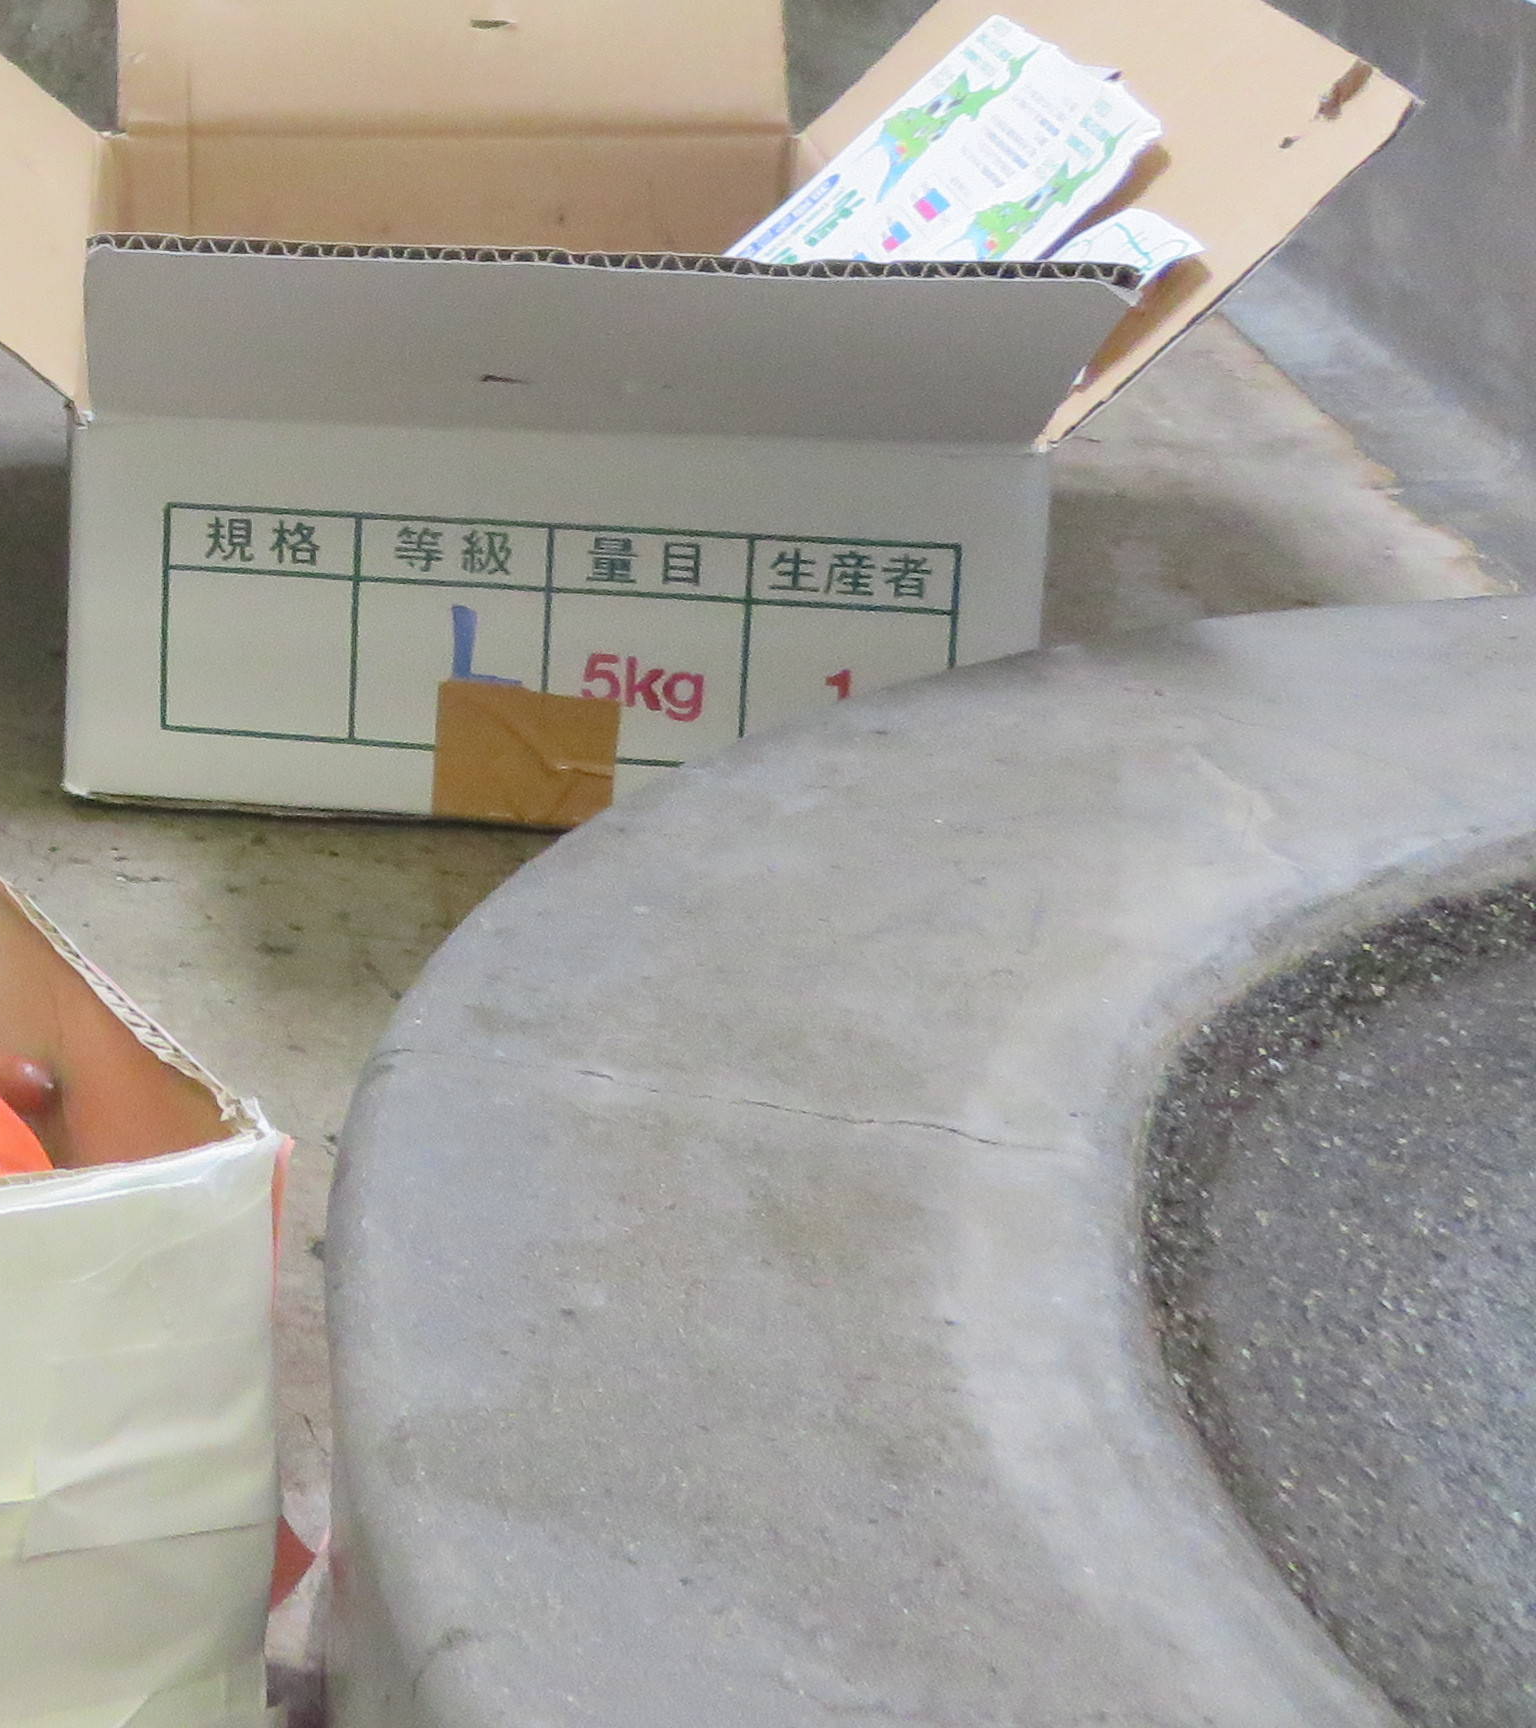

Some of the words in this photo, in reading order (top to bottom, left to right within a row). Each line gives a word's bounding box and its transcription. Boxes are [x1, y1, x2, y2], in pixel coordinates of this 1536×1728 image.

[204, 518, 322, 566] 規格
[394, 527, 514, 577] 等級
[586, 536, 703, 587] 量目
[768, 548, 934, 601] 生産者
[580, 652, 707, 723] 5kg
